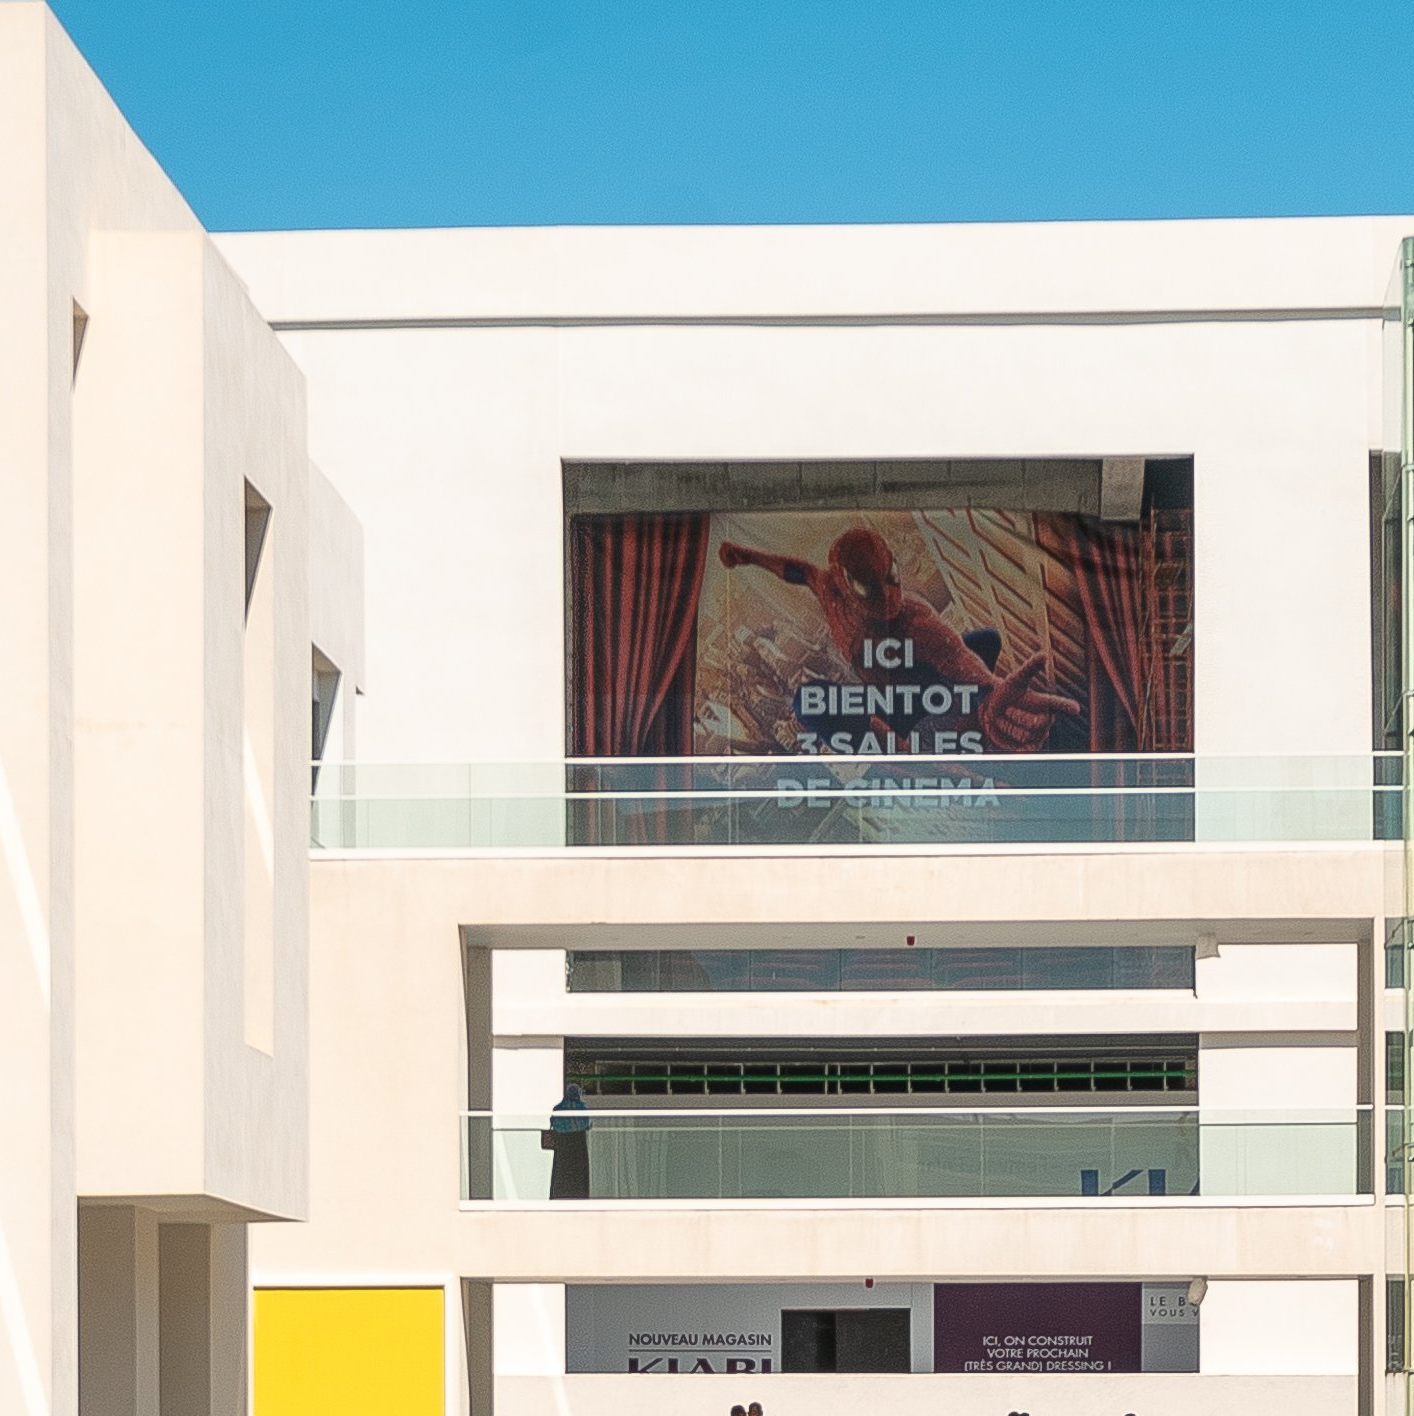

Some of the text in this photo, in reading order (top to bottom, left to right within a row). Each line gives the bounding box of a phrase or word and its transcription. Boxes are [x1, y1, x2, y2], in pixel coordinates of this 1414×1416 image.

[863, 638, 914, 669] ICI
[800, 684, 979, 716] BIENTOT
[797, 731, 818, 754] 3
[776, 777, 1001, 808] DE CINEMA
[1150, 1296, 1166, 1306] LE
[1149, 1308, 1185, 1317] VOUS
[628, 1333, 772, 1346] NOUVEAU MAGASIN
[1004, 1335, 1025, 1346] ON
[1028, 1335, 1093, 1346] CONSTRUIT
[987, 1348, 1089, 1359] VOTRE PROCHAIN
[1046, 1360, 1105, 1371] DRESSING
